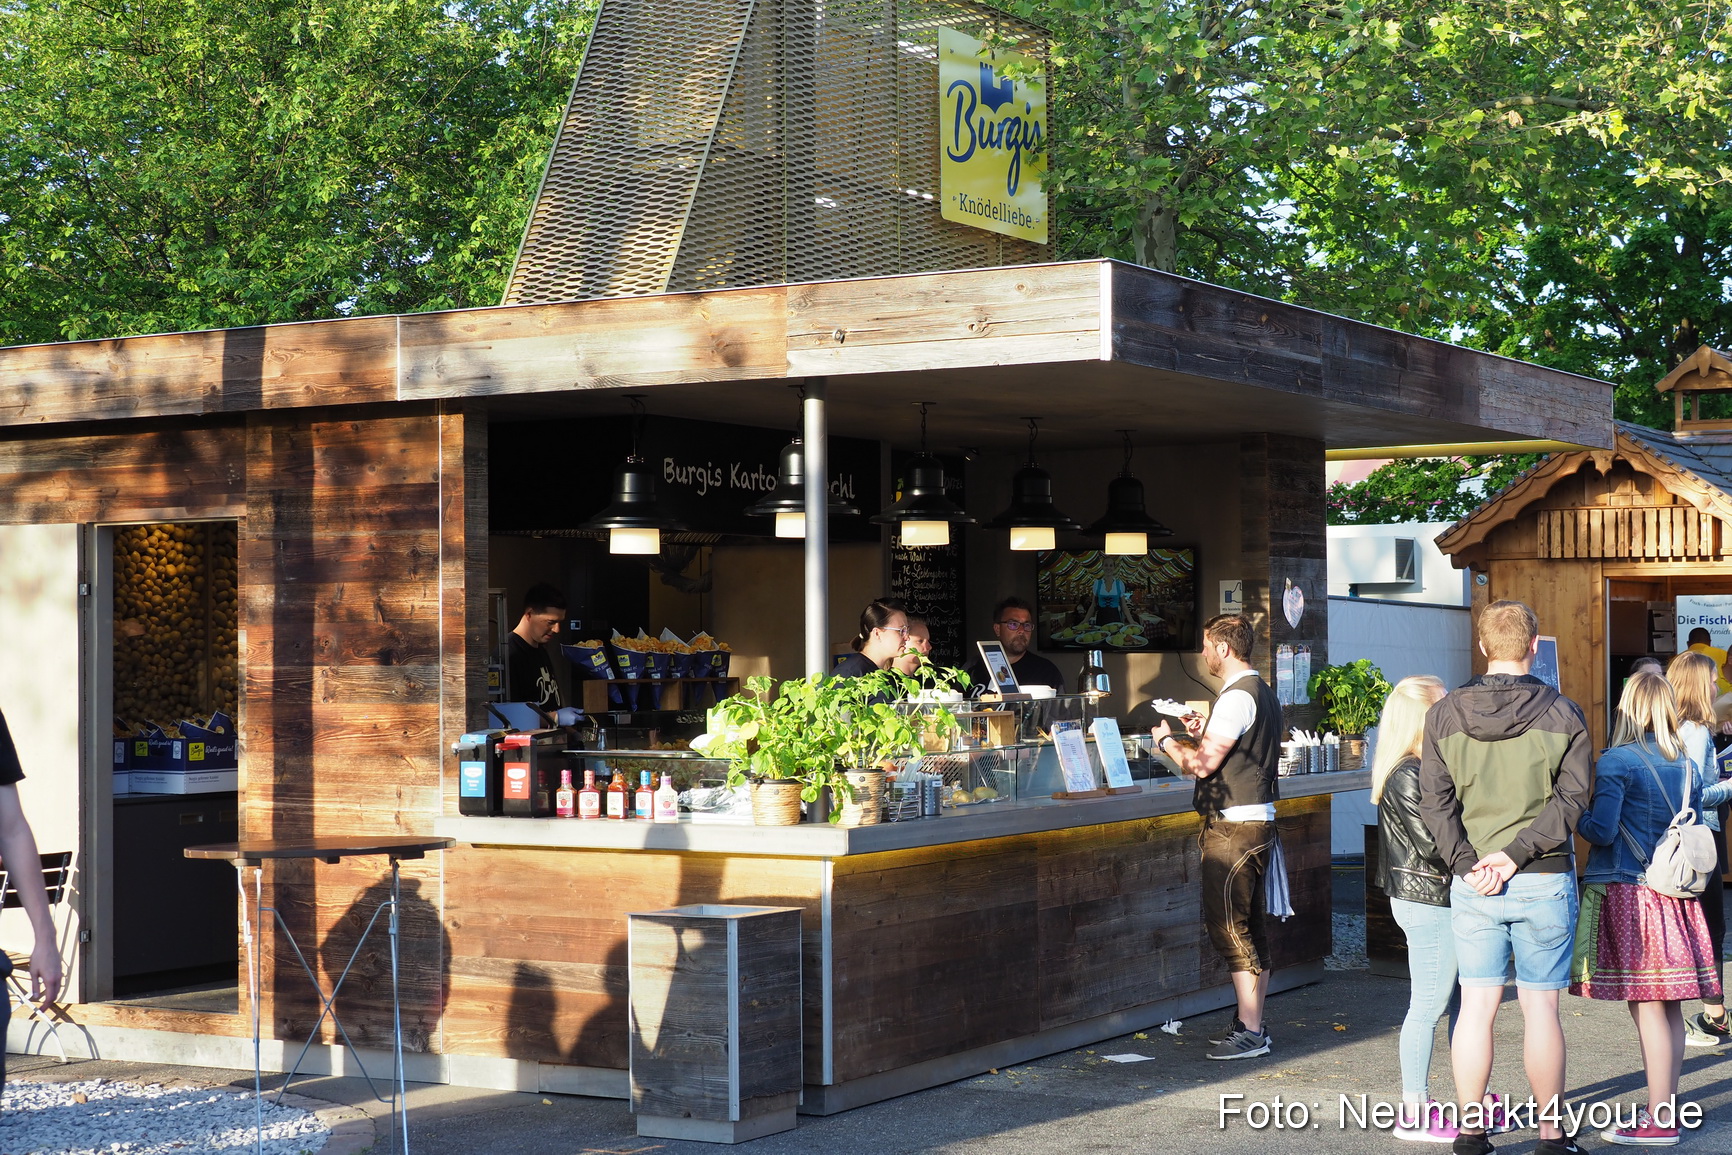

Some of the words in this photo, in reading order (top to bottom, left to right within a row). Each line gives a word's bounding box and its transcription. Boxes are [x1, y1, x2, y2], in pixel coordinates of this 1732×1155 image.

[946, 79, 1042, 197] Burgis
[959, 192, 1036, 230] Knödelliebe.
[663, 456, 723, 497] Burgis
[1677, 615, 1696, 625] Die
